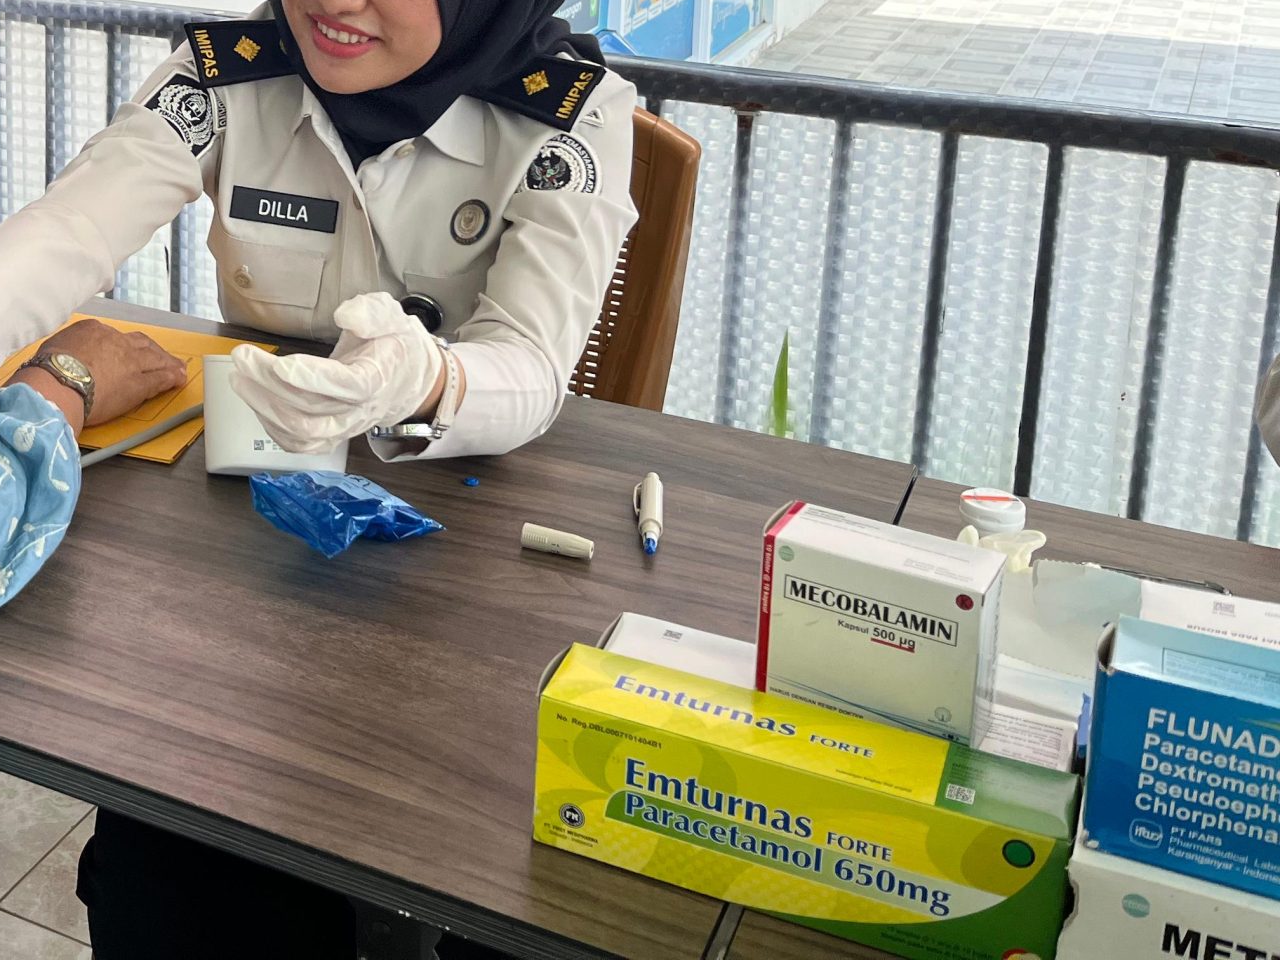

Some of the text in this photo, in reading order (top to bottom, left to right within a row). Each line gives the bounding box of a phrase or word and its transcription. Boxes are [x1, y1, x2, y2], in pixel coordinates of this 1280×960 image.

[193, 29, 219, 78] IMIPAS
[555, 69, 594, 121] IMIPAS
[258, 197, 309, 223] DILLA
[789, 579, 954, 641] MECOBALAMIN
[837, 619, 869, 635] Kapsul
[873, 626, 896, 643] 500
[613, 674, 874, 758] Emturnas FORTE
[625, 757, 813, 839] Emturnas
[826, 831, 892, 862] FORTE
[1134, 792, 1280, 845] Chlorphena
[1137, 772, 1280, 823] Pseudoeph
[624, 792, 952, 917] Paracetamol 650mg
[1169, 837, 1249, 864] Pharmaceutical
[1170, 826, 1223, 847] PT IFARS
[1162, 922, 1280, 960] MET
